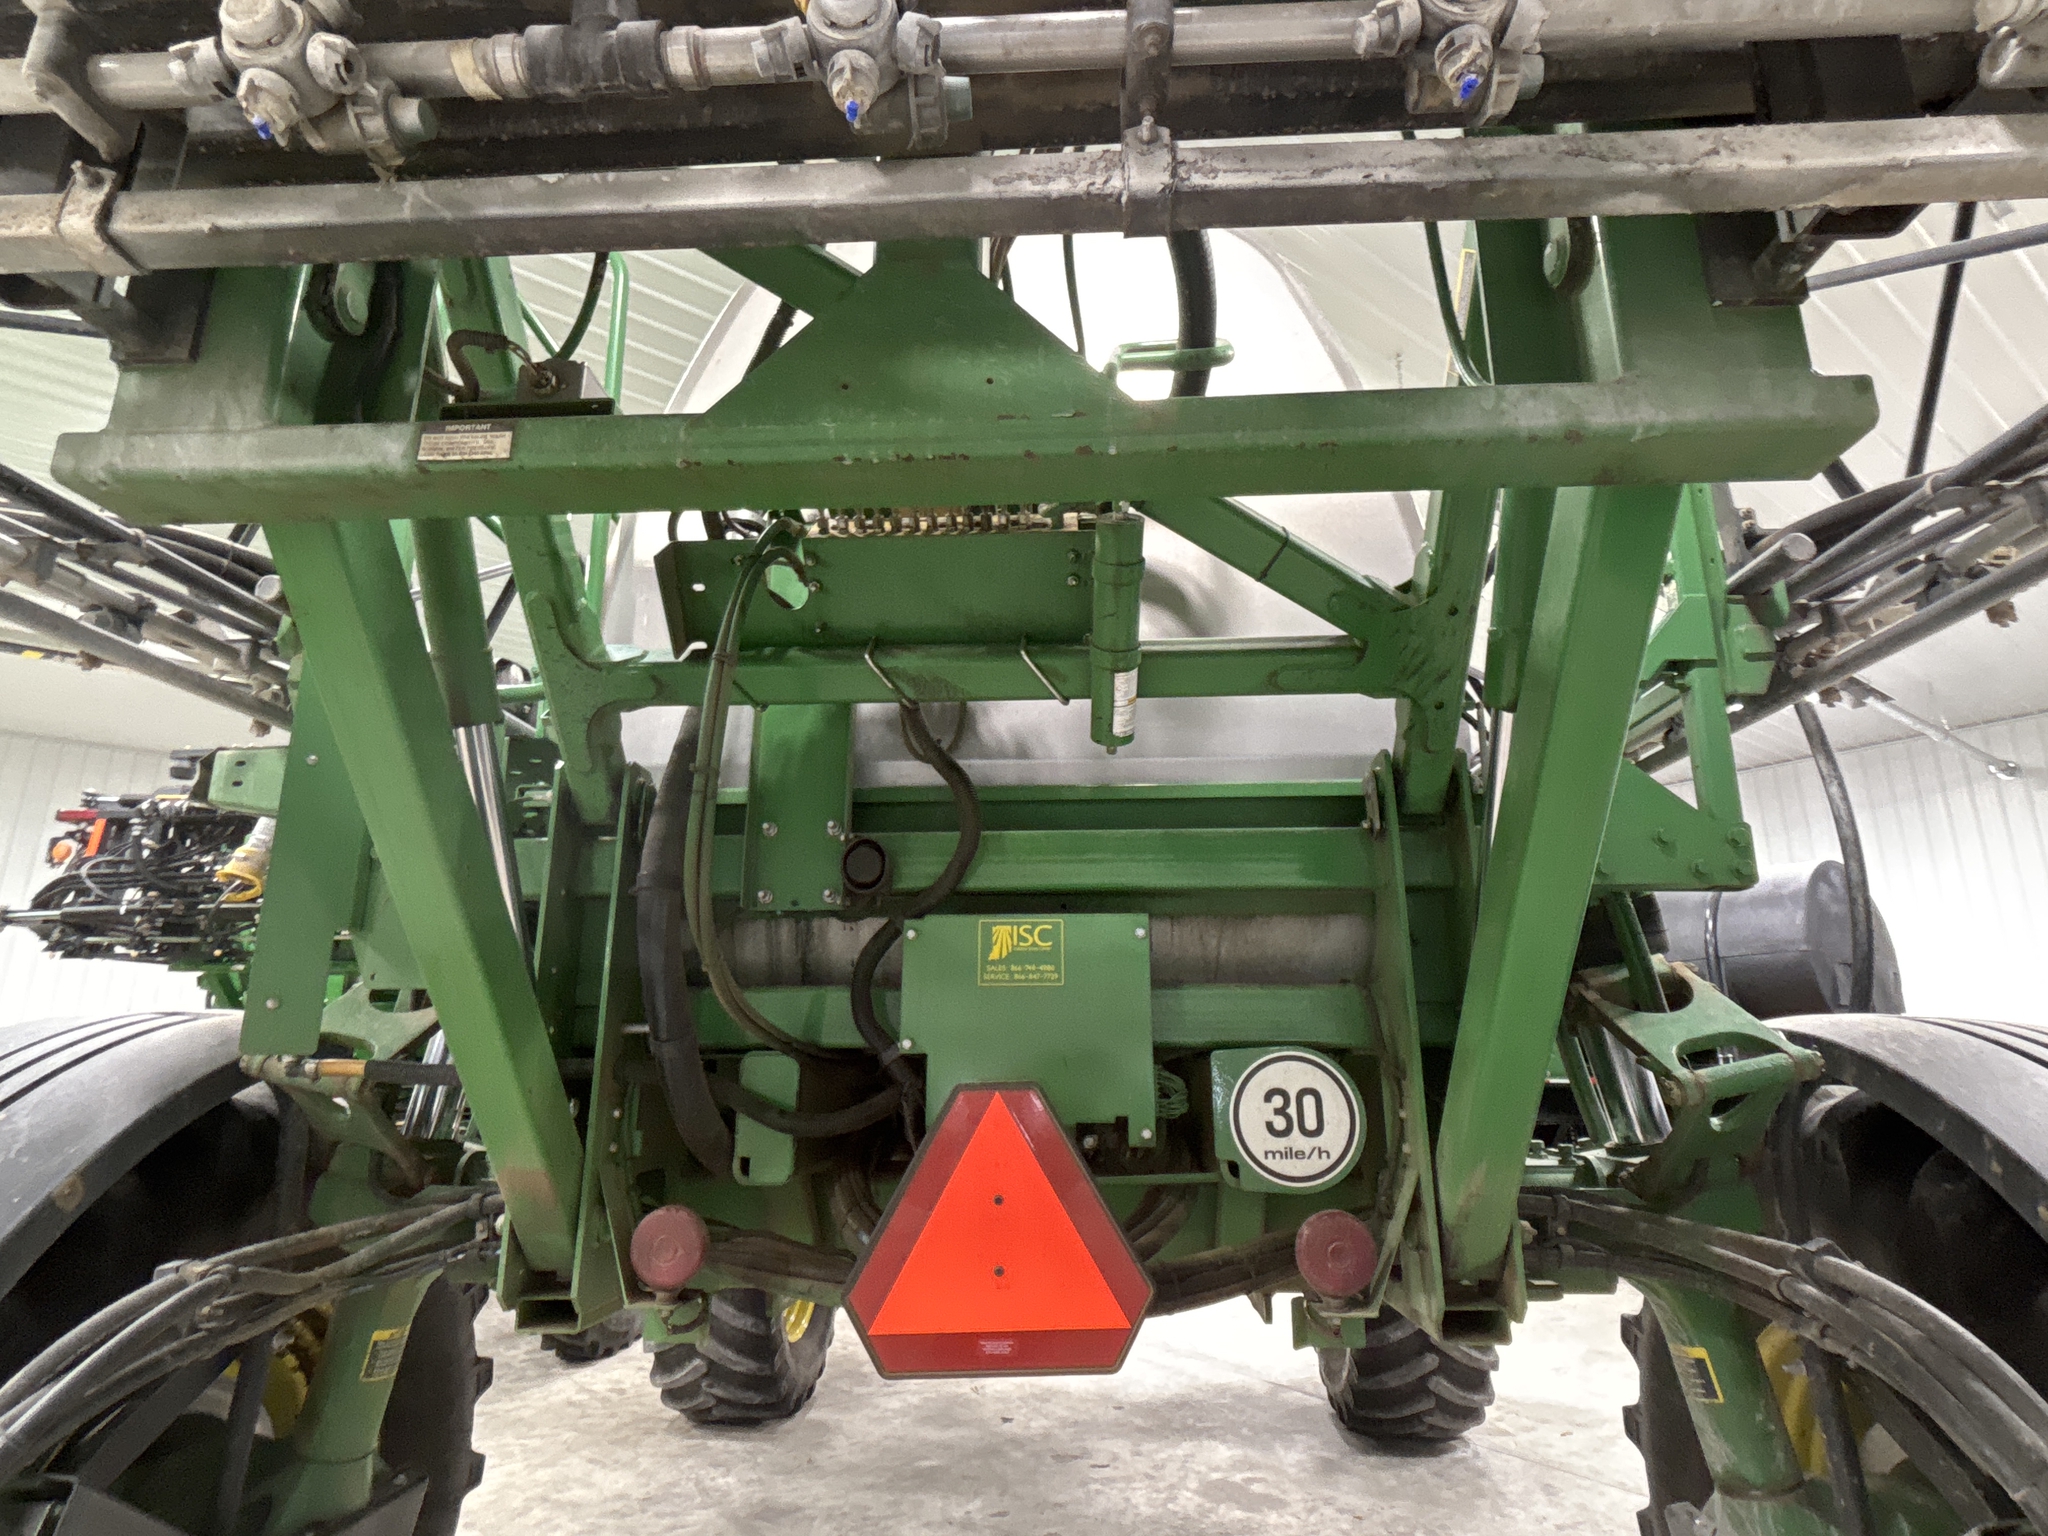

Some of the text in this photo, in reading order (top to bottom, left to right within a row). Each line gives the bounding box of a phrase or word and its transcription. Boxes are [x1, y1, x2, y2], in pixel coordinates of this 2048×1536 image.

[445, 423, 492, 432] IMPORTANT
[1013, 924, 1053, 947] ISC
[1263, 1087, 1325, 1138] 30
[1263, 1146, 1331, 1160] mile/h
